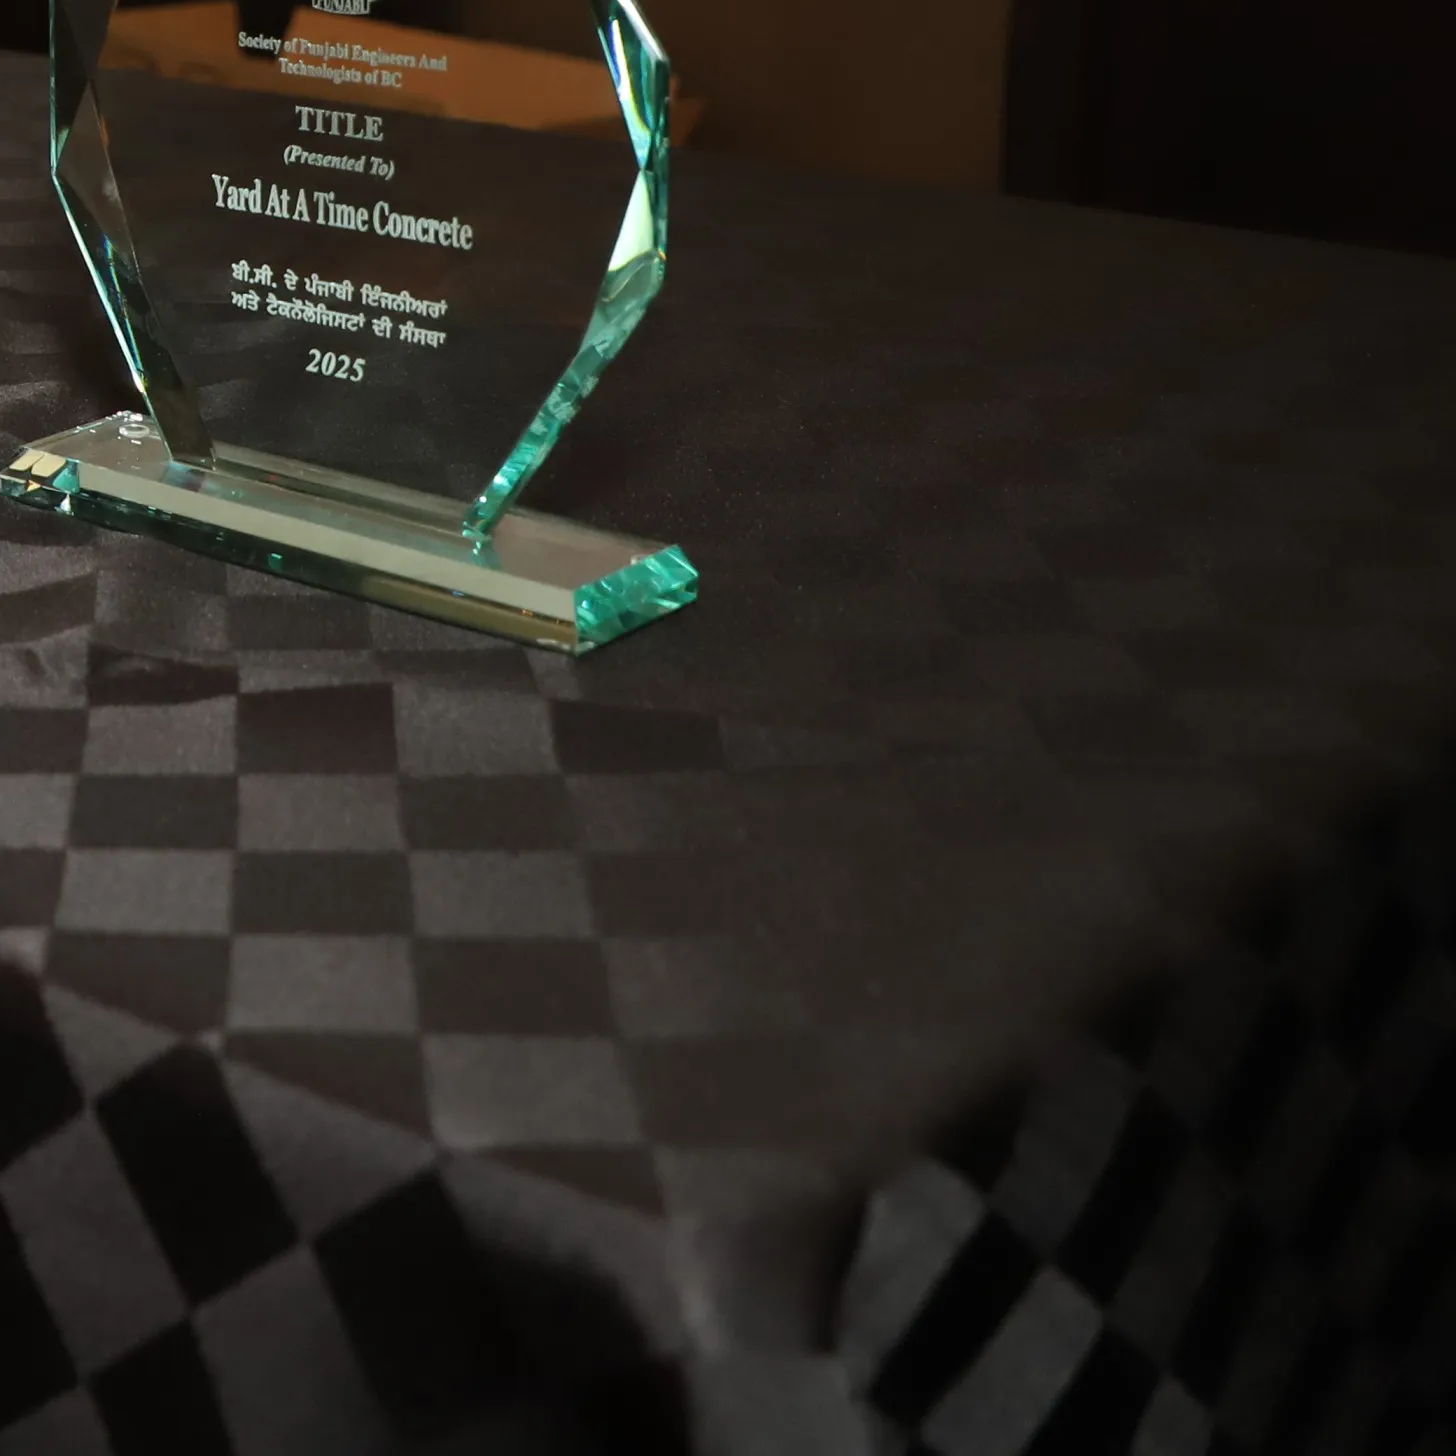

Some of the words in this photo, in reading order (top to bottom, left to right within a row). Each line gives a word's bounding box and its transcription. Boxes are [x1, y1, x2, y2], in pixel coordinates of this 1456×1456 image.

[238, 31, 281, 54] Society
[284, 37, 299, 53] of
[299, 39, 348, 60] Punjabi
[351, 45, 416, 67] Engineers
[419, 54, 447, 71] And
[279, 58, 362, 83] Technologists
[364, 69, 380, 83] of
[380, 70, 402, 87] BC
[295, 106, 384, 142] TITLE
[283, 144, 365, 174] (Presented
[369, 156, 395, 180] To)
[211, 173, 262, 214] Yard
[265, 184, 290, 218] At
[292, 189, 311, 223] A
[313, 191, 368, 232] Time
[373, 201, 473, 250] Concrete
[305, 348, 366, 382] 2025
